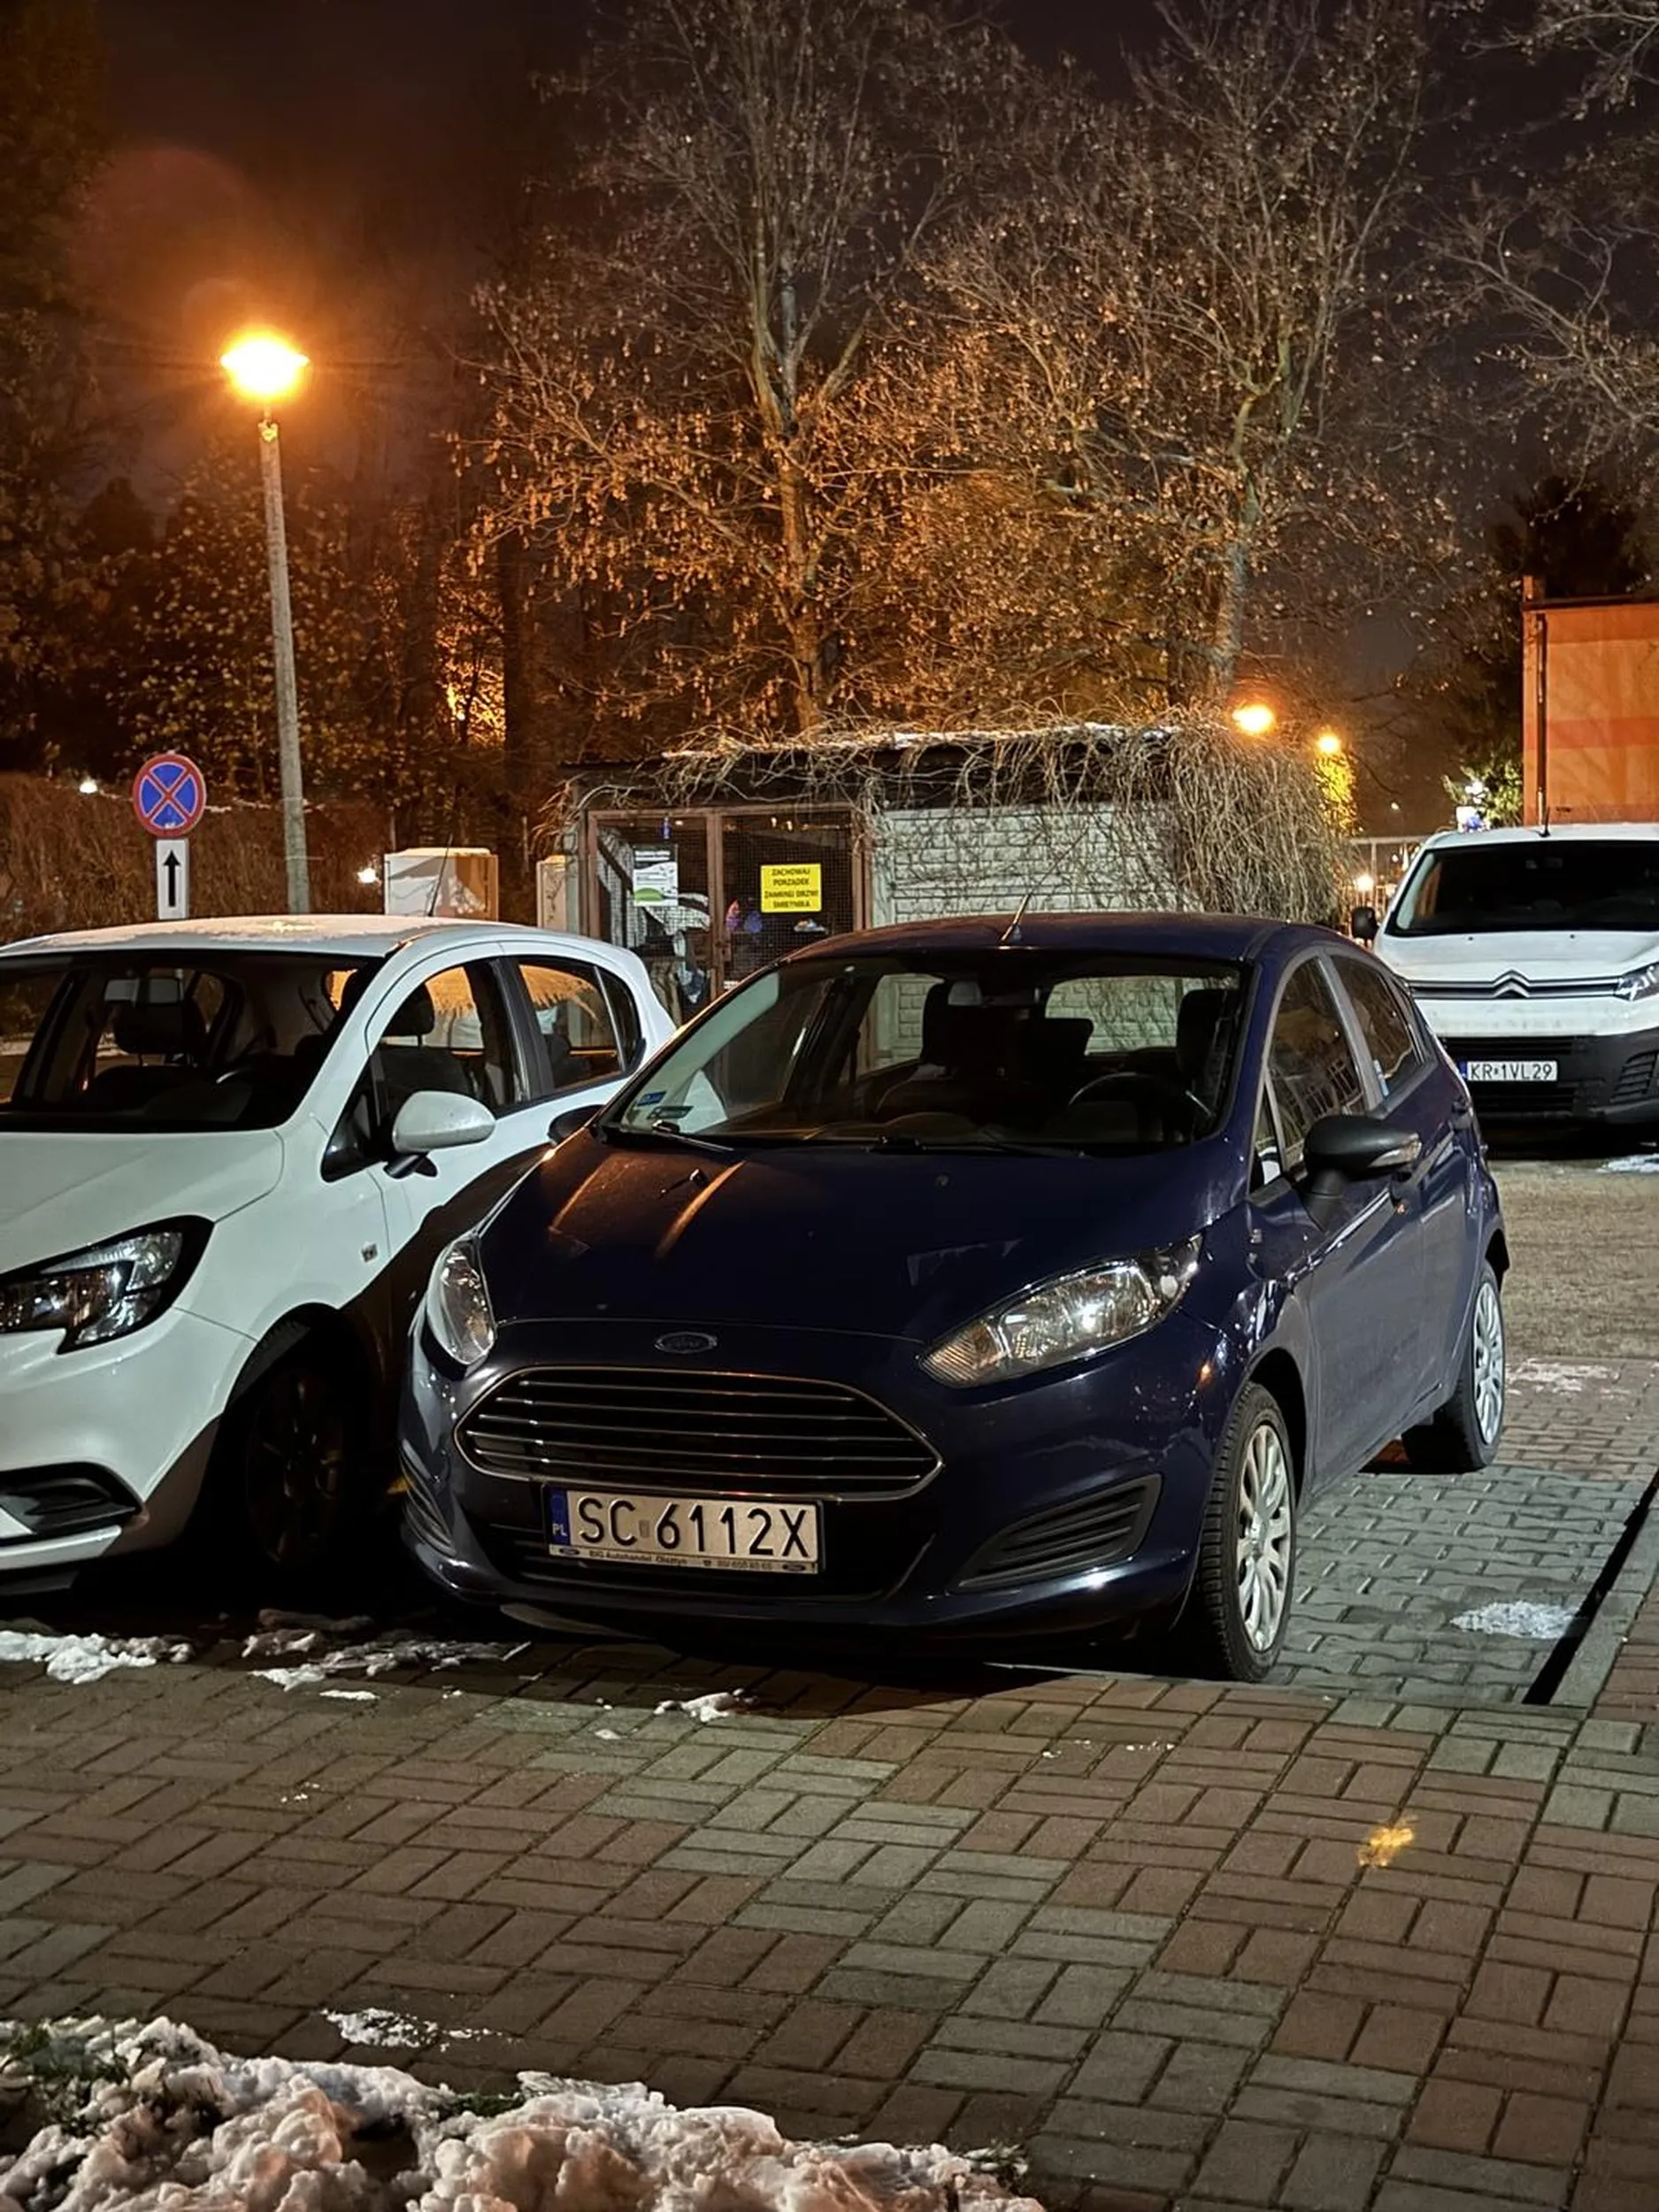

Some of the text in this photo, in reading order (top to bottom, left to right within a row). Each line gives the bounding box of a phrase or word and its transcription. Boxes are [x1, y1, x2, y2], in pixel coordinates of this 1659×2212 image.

[1471, 1064, 1553, 1079] KR 1VL29
[552, 1523, 567, 1537] PL
[578, 1497, 808, 1557] SC 6112X
